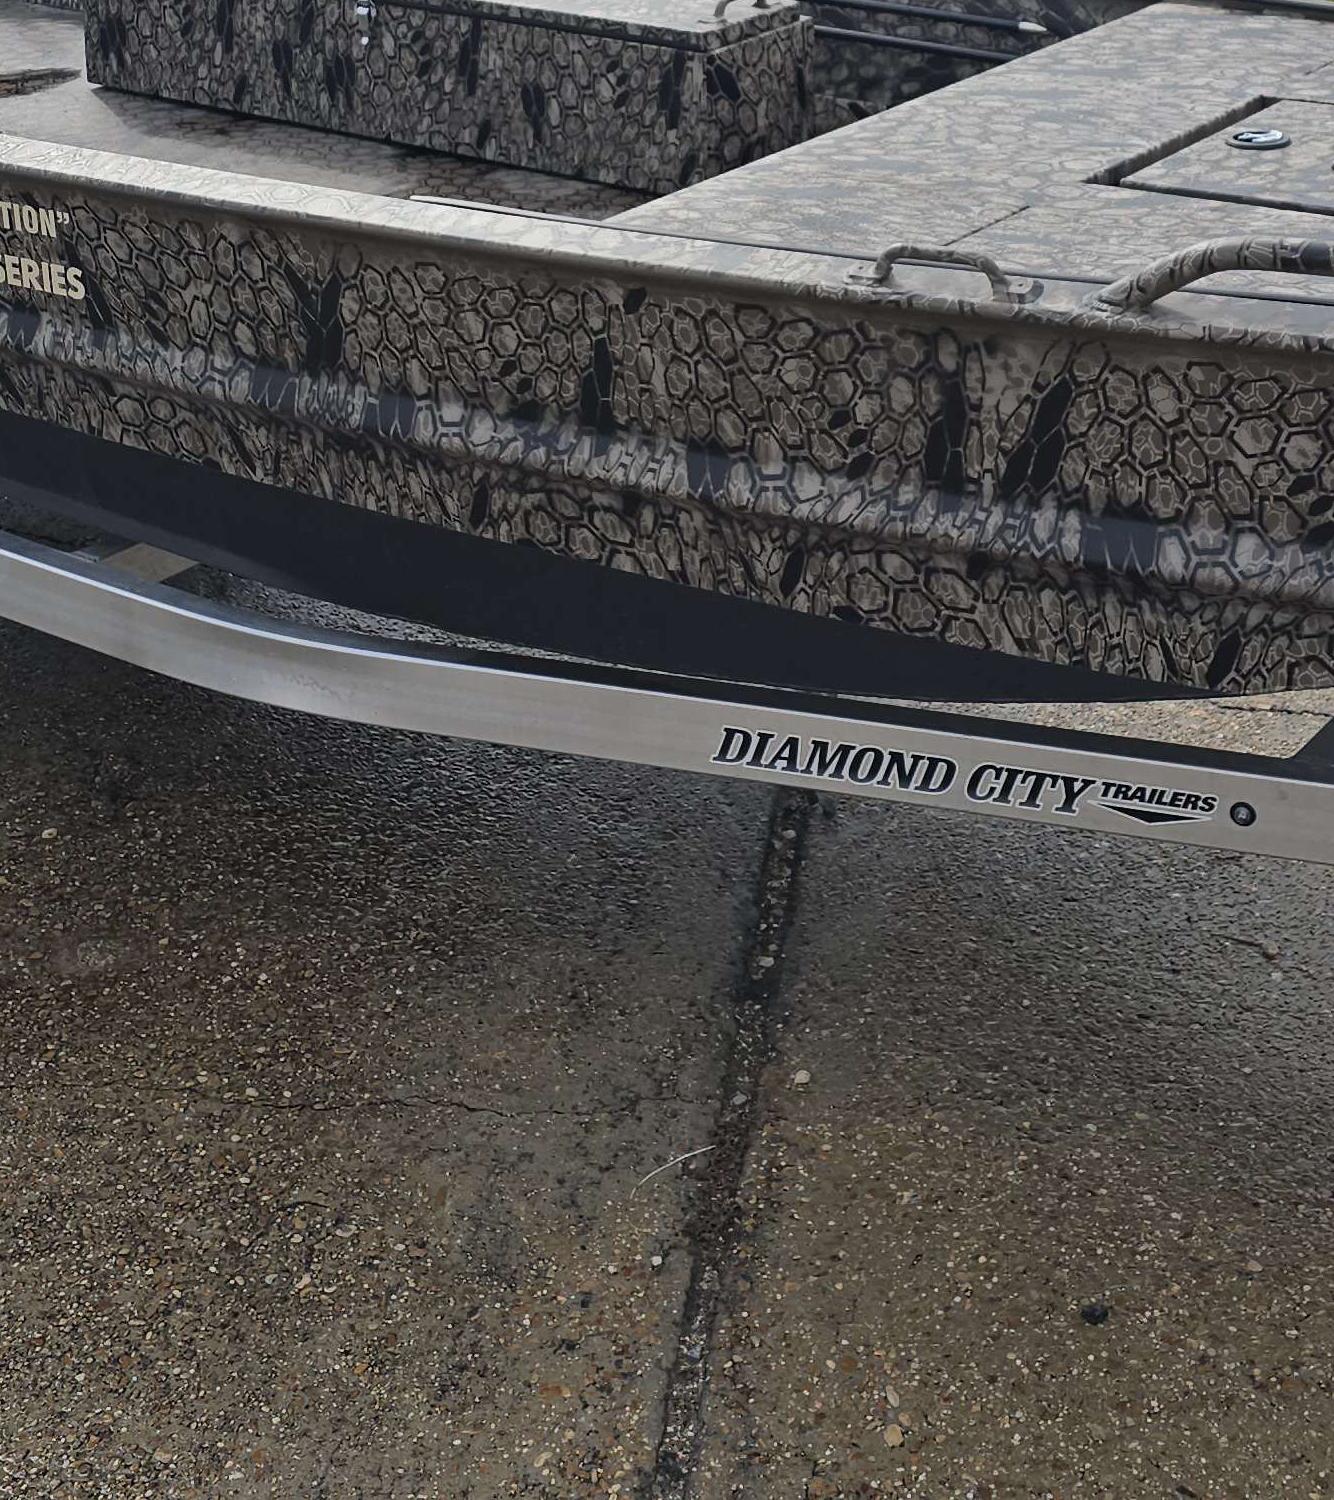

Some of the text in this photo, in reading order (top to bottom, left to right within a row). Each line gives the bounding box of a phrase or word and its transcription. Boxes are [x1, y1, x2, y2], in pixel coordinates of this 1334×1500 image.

[710, 726, 1219, 817] DIAMOND CITY TRAILERS
